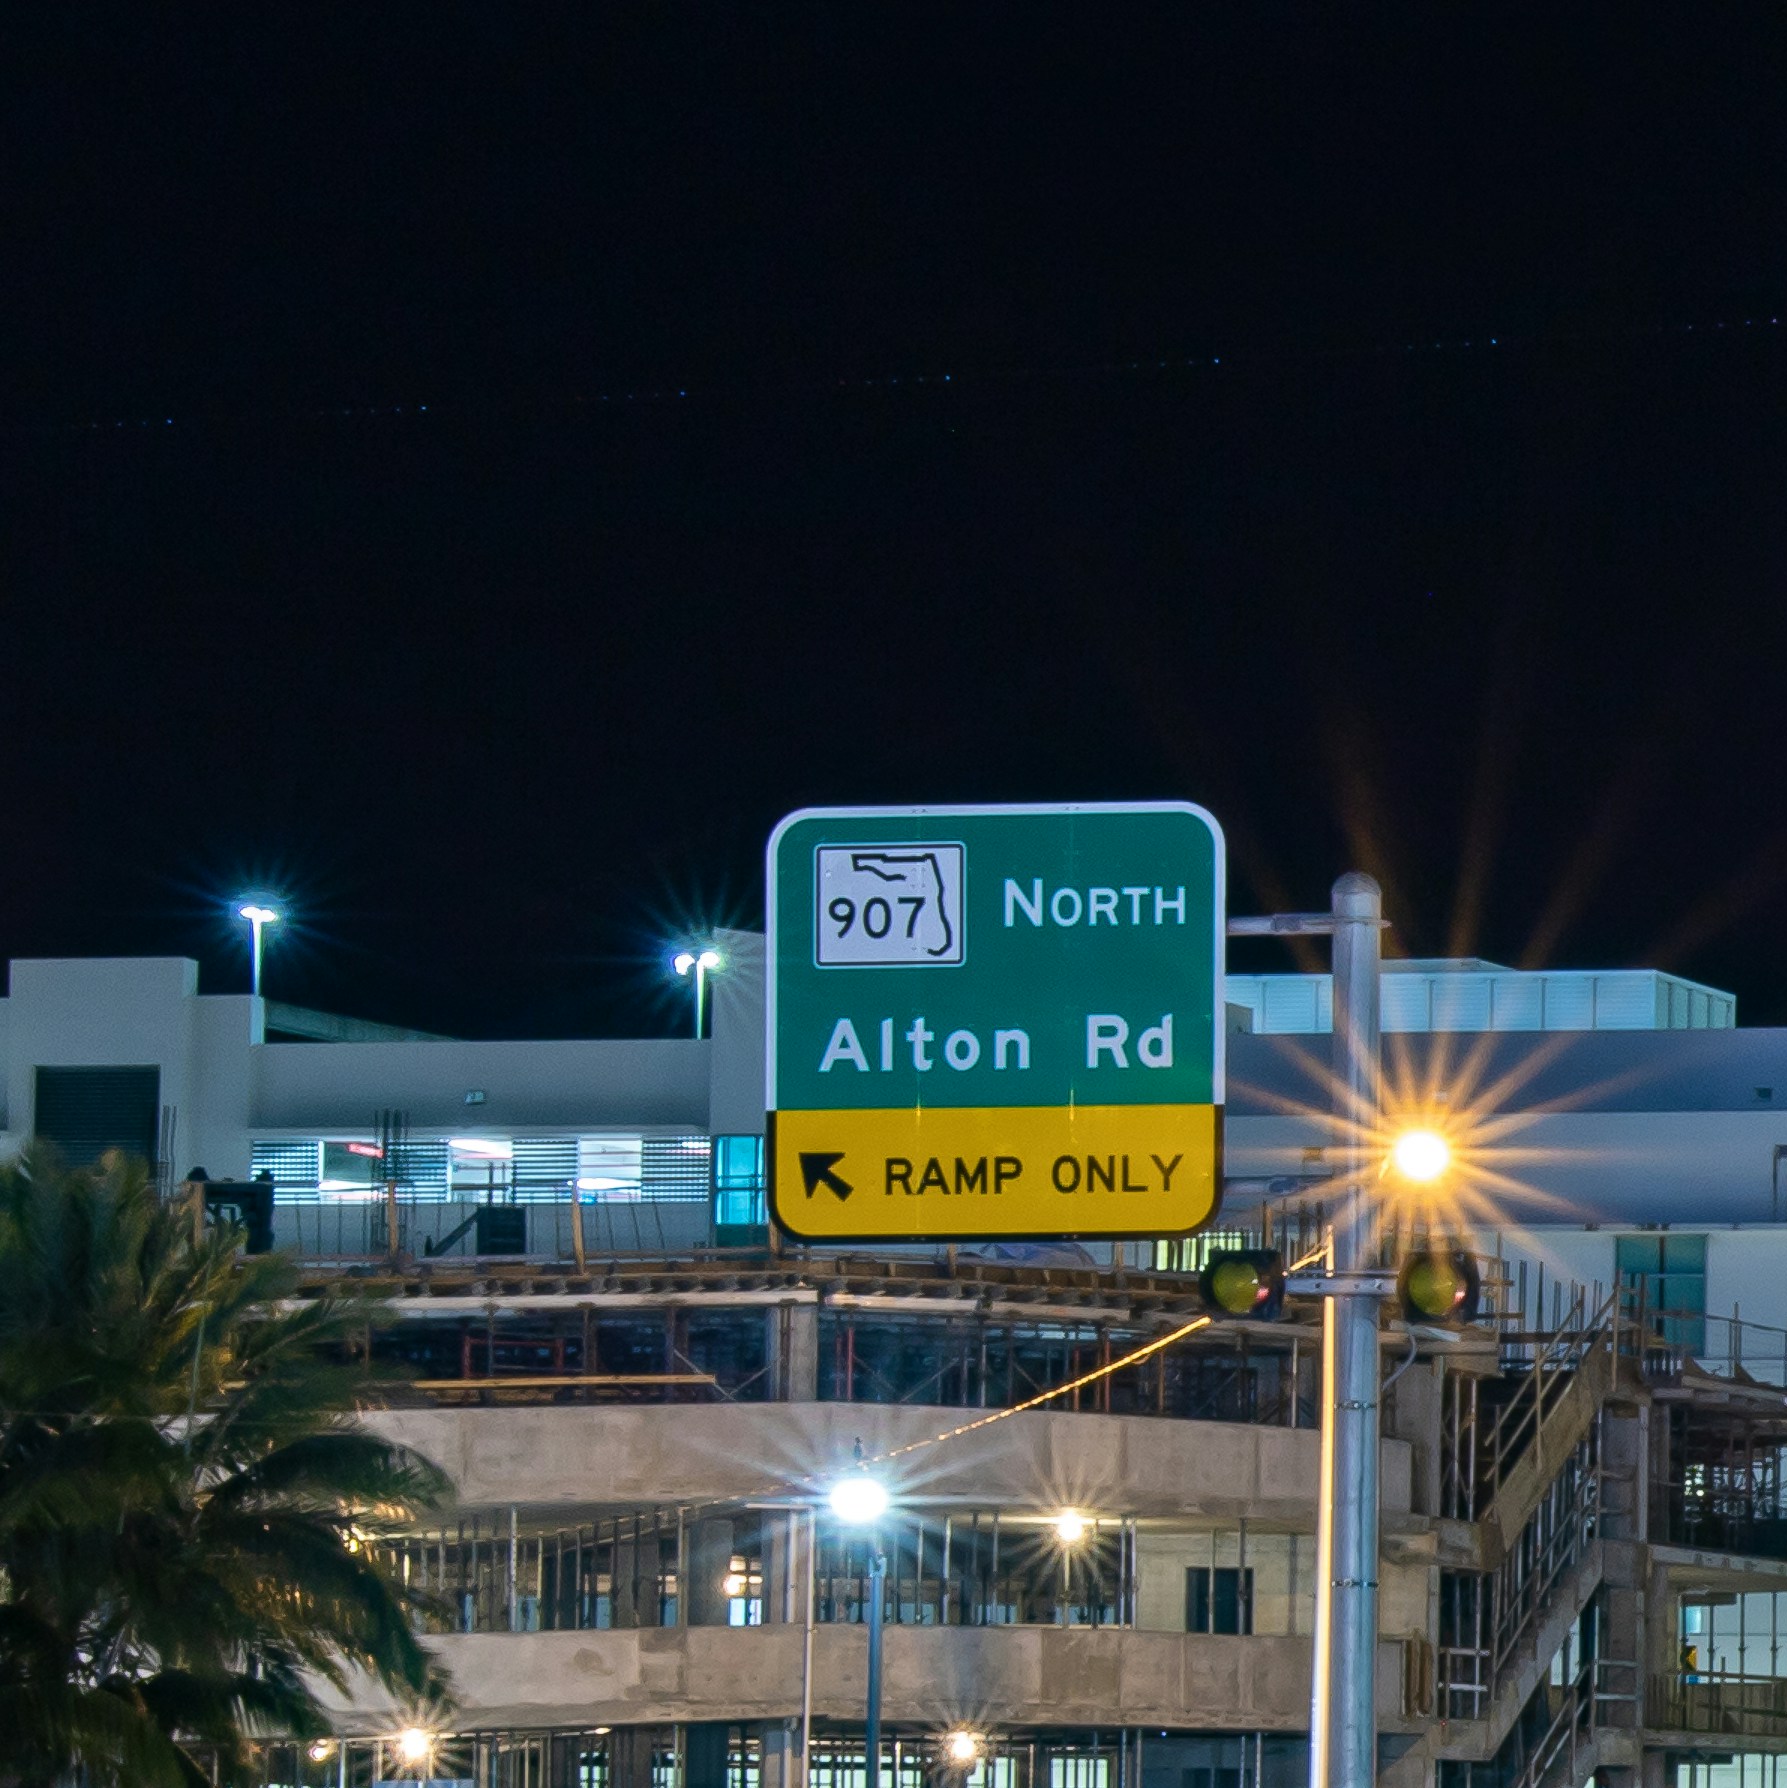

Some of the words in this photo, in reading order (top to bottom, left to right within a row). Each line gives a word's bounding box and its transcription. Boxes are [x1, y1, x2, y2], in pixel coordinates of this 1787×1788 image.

[828, 896, 927, 939] 907
[1003, 878, 1186, 928] NORTH
[818, 1015, 1031, 1073] Alton
[1085, 1012, 1175, 1069] Rd
[884, 1156, 1023, 1196] RAMP
[1051, 1153, 1184, 1194] ONLY
